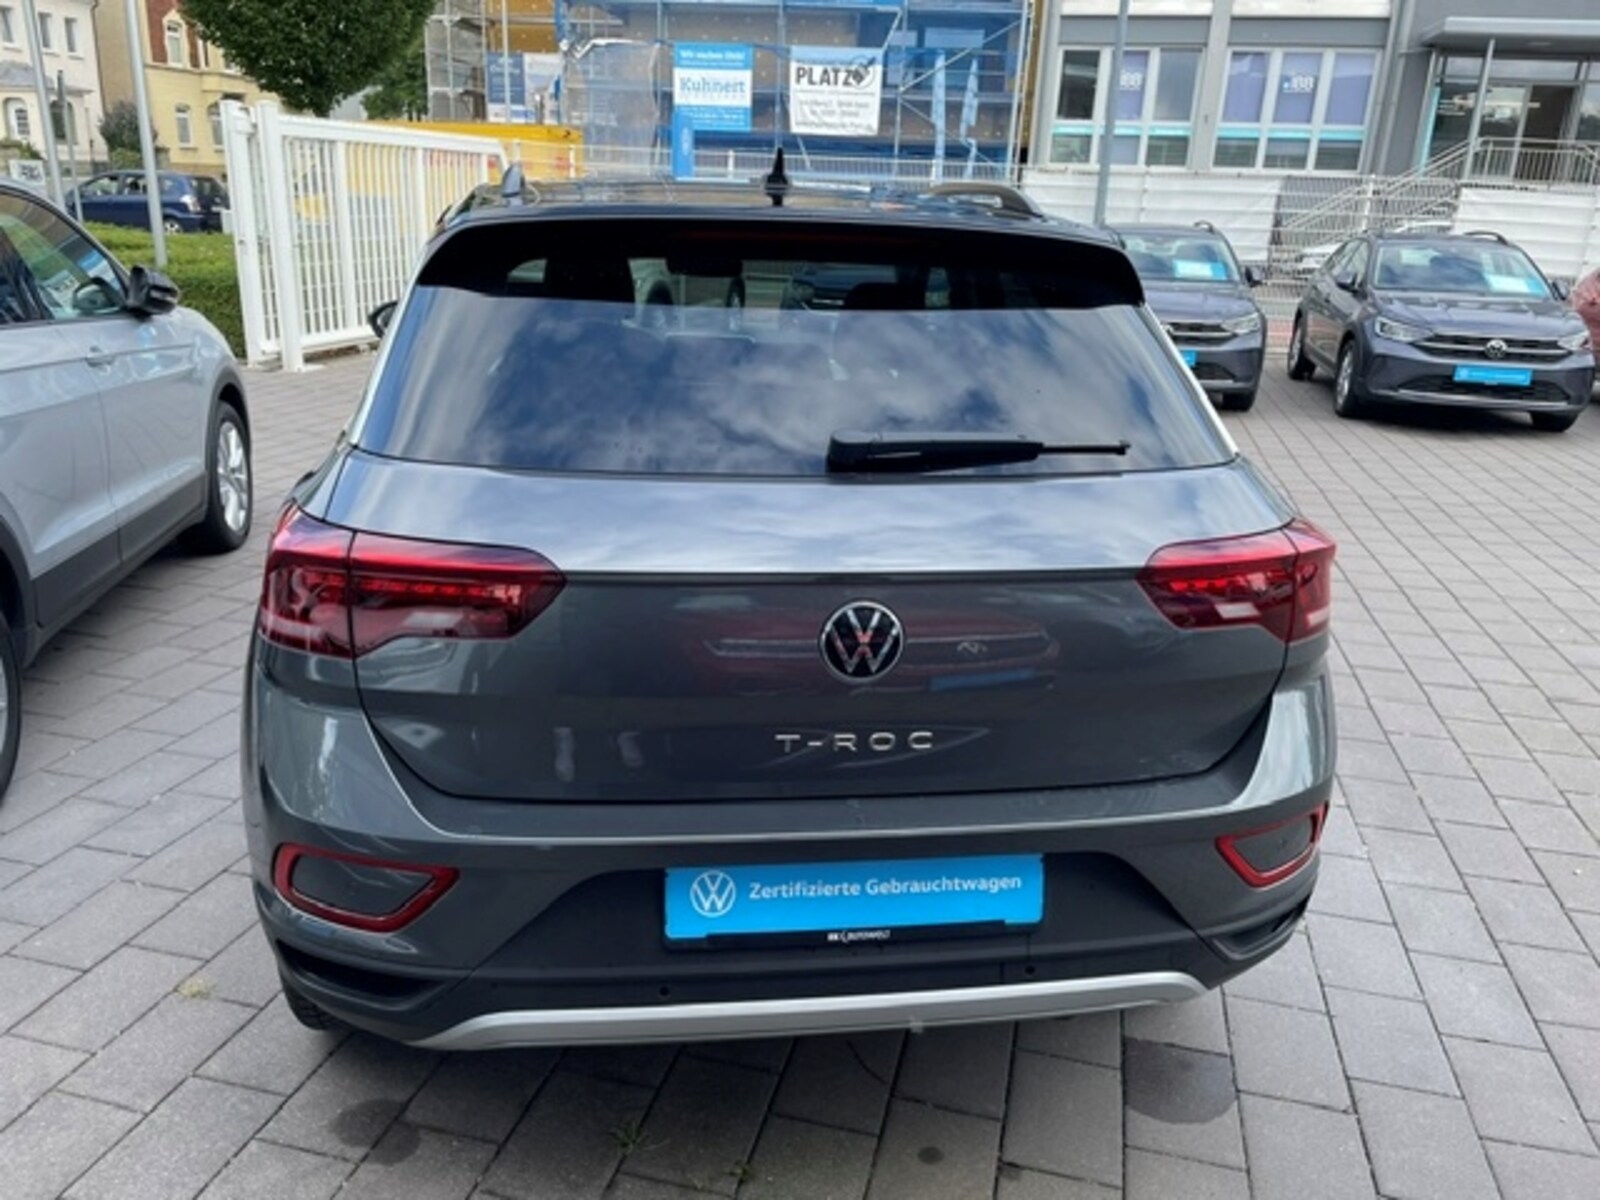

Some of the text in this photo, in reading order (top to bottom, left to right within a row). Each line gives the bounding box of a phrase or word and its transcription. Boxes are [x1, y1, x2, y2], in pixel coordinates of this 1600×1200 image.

[679, 77, 746, 93] Kuhnert
[775, 731, 934, 754] T-ROC
[749, 874, 1022, 900] Zertifizierte Gebrauchtwagen
